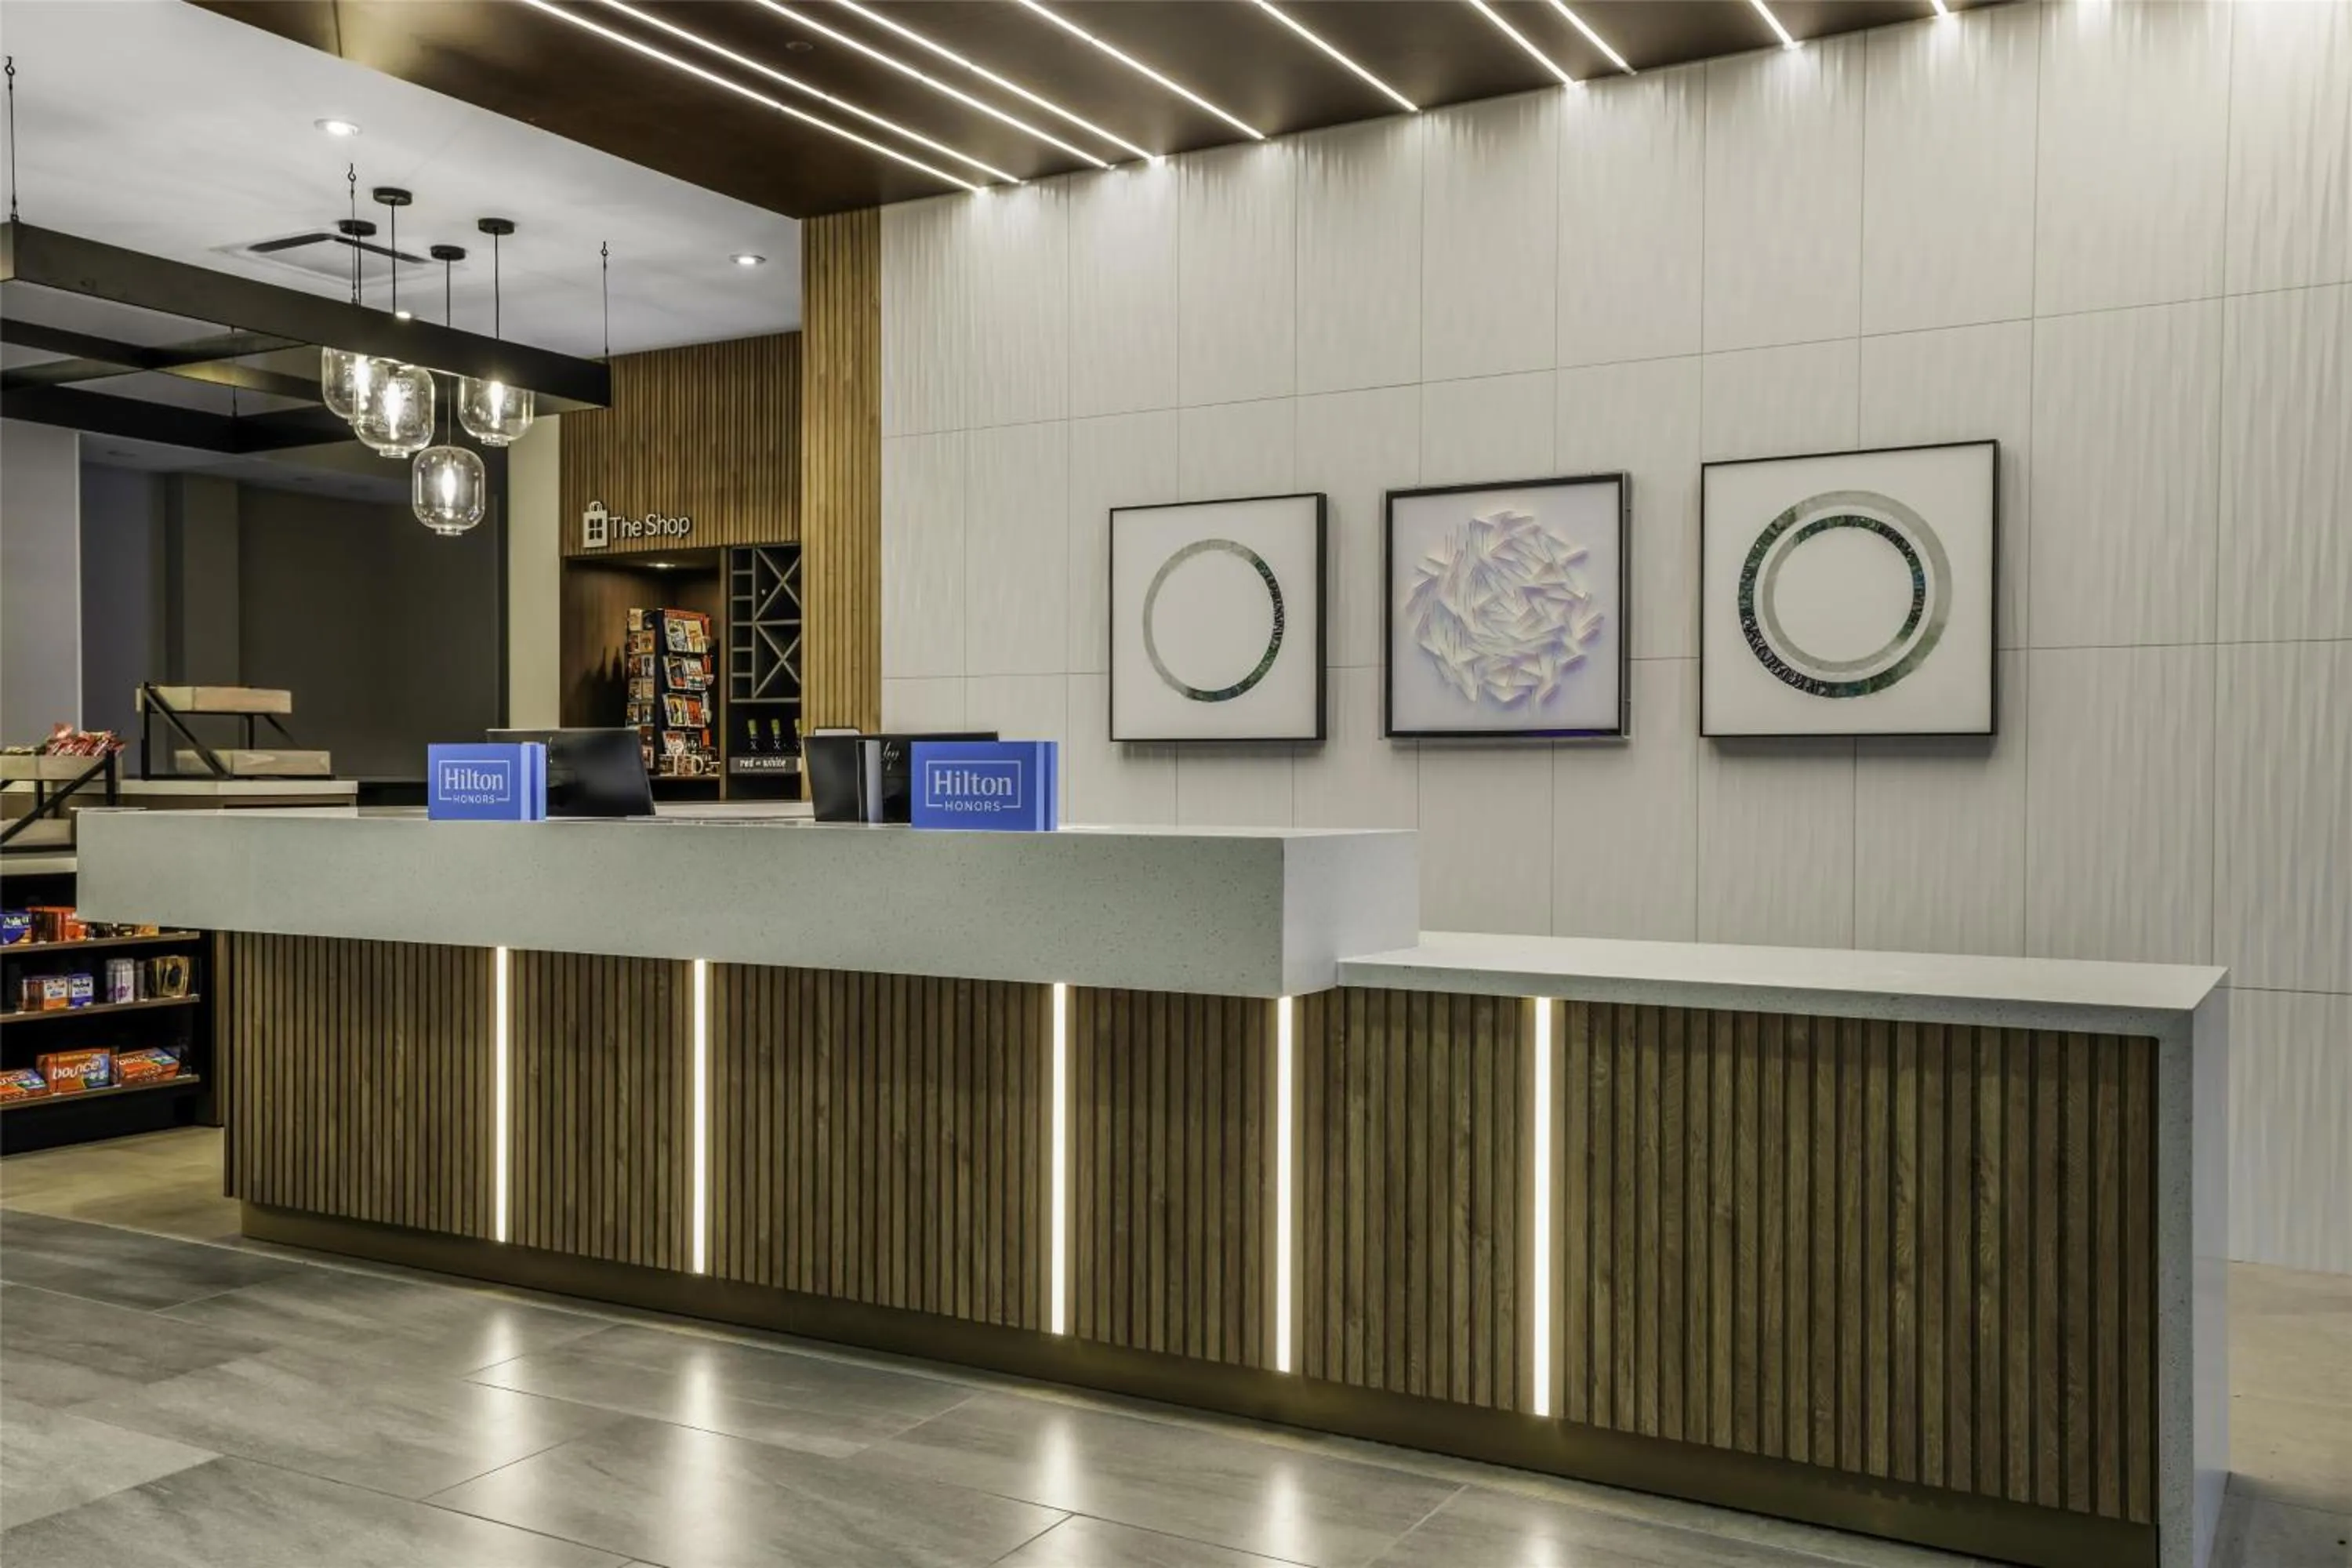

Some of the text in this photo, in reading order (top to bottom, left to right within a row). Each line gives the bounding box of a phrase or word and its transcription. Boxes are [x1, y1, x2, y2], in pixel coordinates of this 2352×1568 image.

[608, 513, 691, 539] The Shop
[445, 768, 503, 790] Hilton
[934, 769, 1013, 797] Hilton
[452, 793, 496, 804] HONORS
[944, 800, 1001, 812] HONORS
[53, 1058, 101, 1080] bounce
